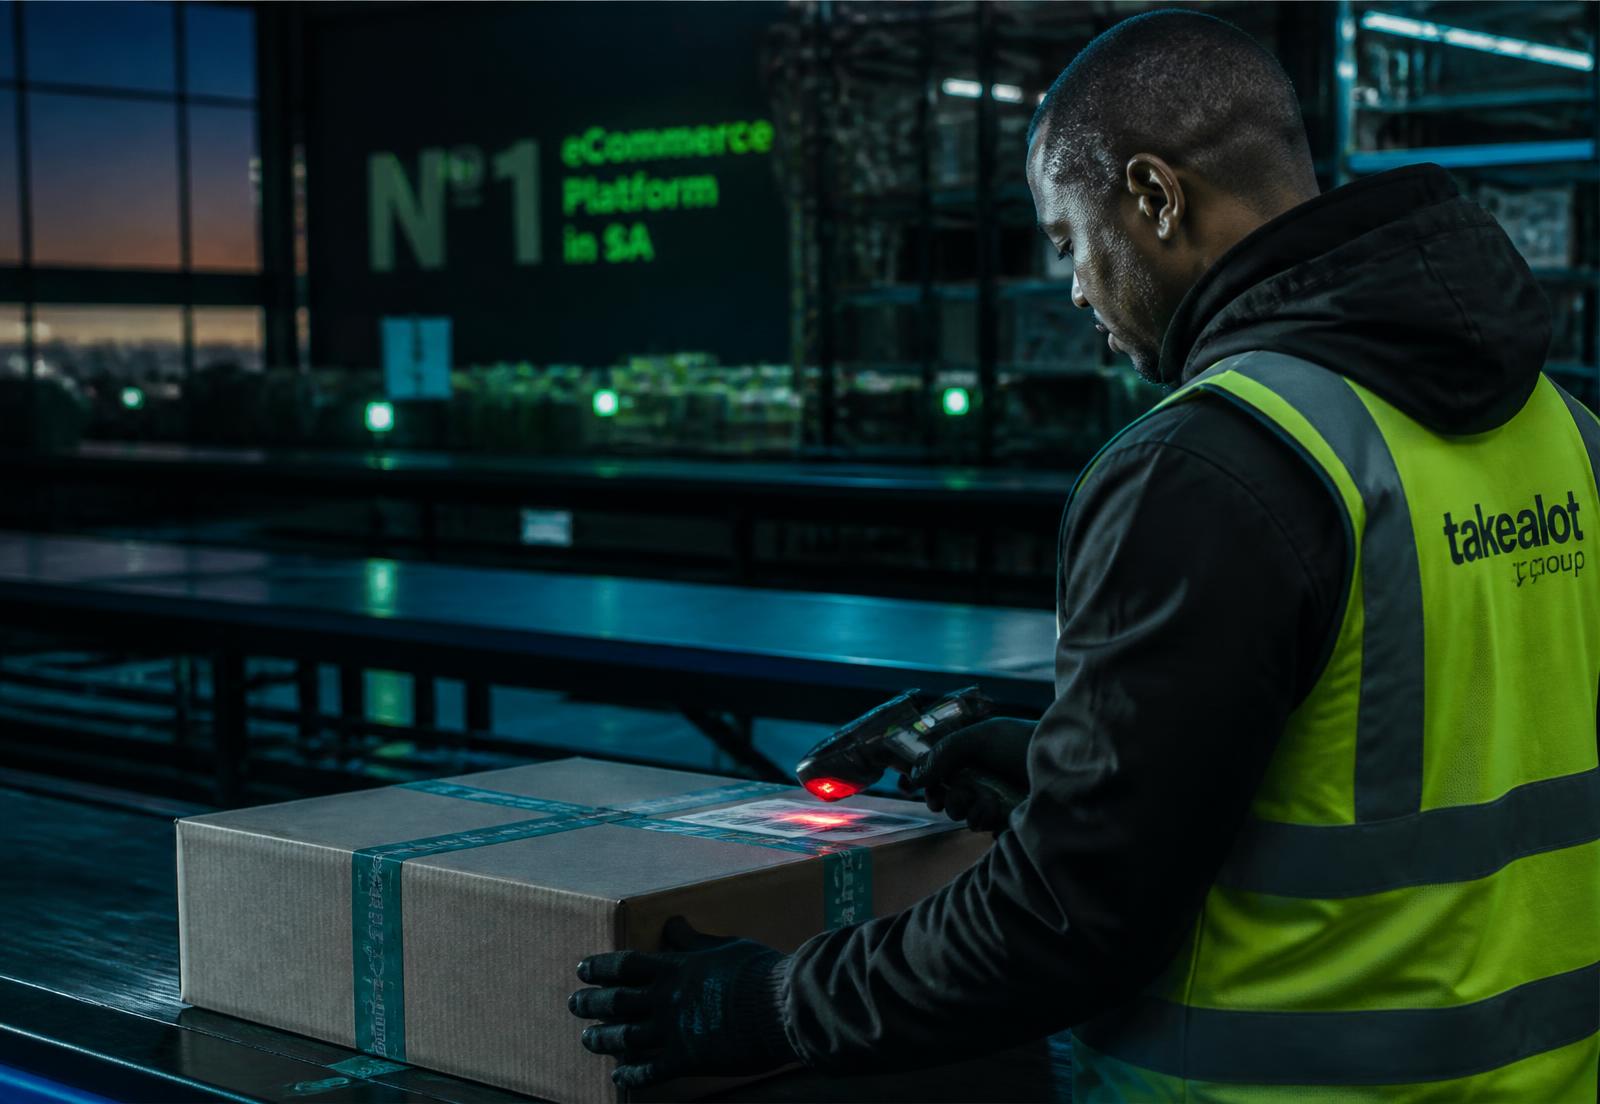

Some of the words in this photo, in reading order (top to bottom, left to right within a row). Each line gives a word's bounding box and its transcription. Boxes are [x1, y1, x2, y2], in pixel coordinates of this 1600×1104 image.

[562, 120, 773, 167] eCommerce
[563, 172, 719, 216] Platform
[564, 225, 598, 263] in
[604, 222, 654, 262] SA
[1443, 491, 1583, 565] takealot
